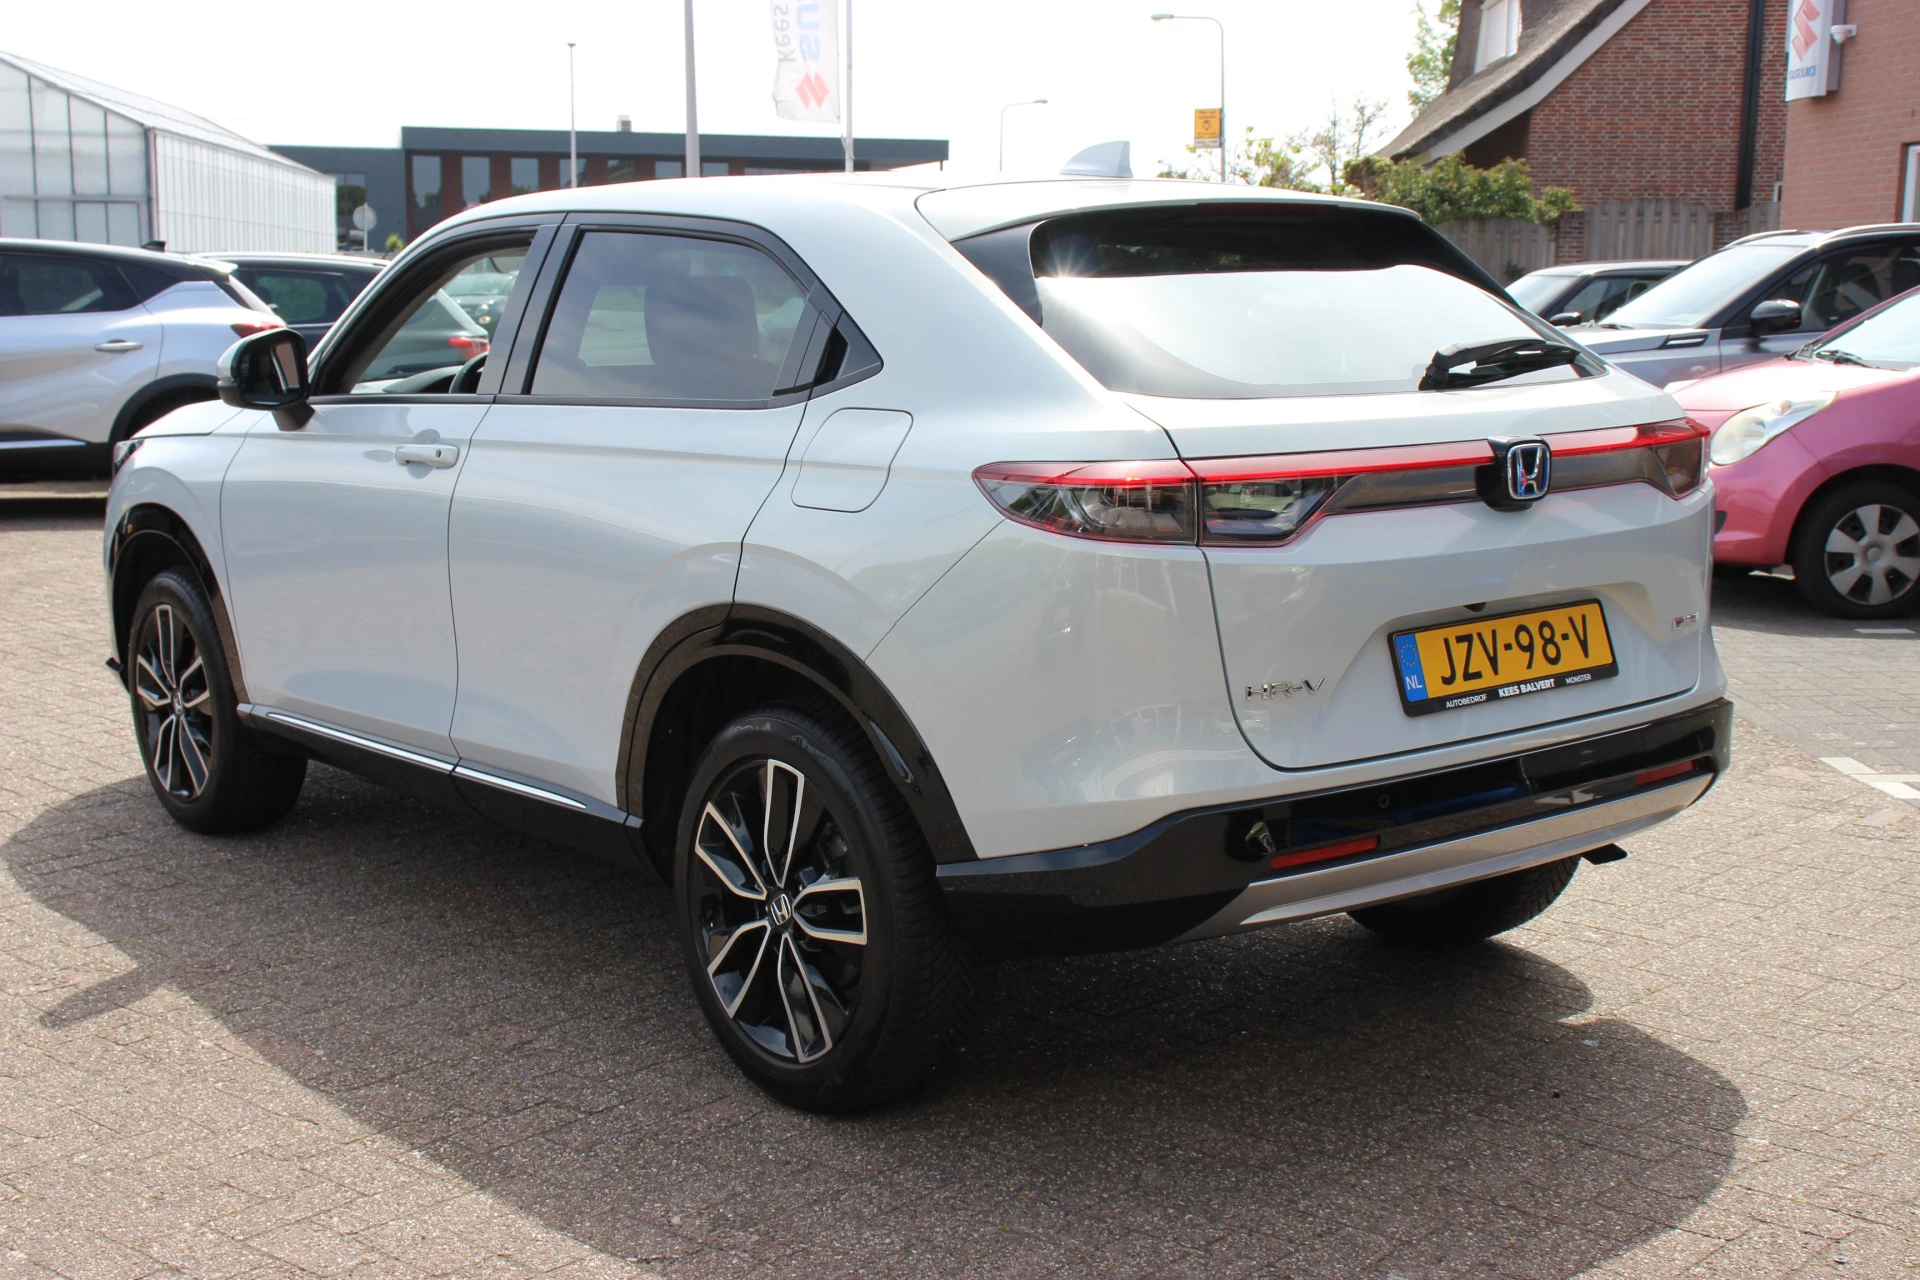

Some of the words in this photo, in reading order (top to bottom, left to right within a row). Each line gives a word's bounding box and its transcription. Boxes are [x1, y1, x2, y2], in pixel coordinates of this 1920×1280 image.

[1440, 614, 1590, 686] JZV-98-V
[1246, 677, 1325, 702] HR-V
[1405, 674, 1423, 690] NL
[1498, 685, 1520, 697] KEES
[1520, 678, 1556, 693] BALVERT
[1565, 673, 1592, 685] MONSTER
